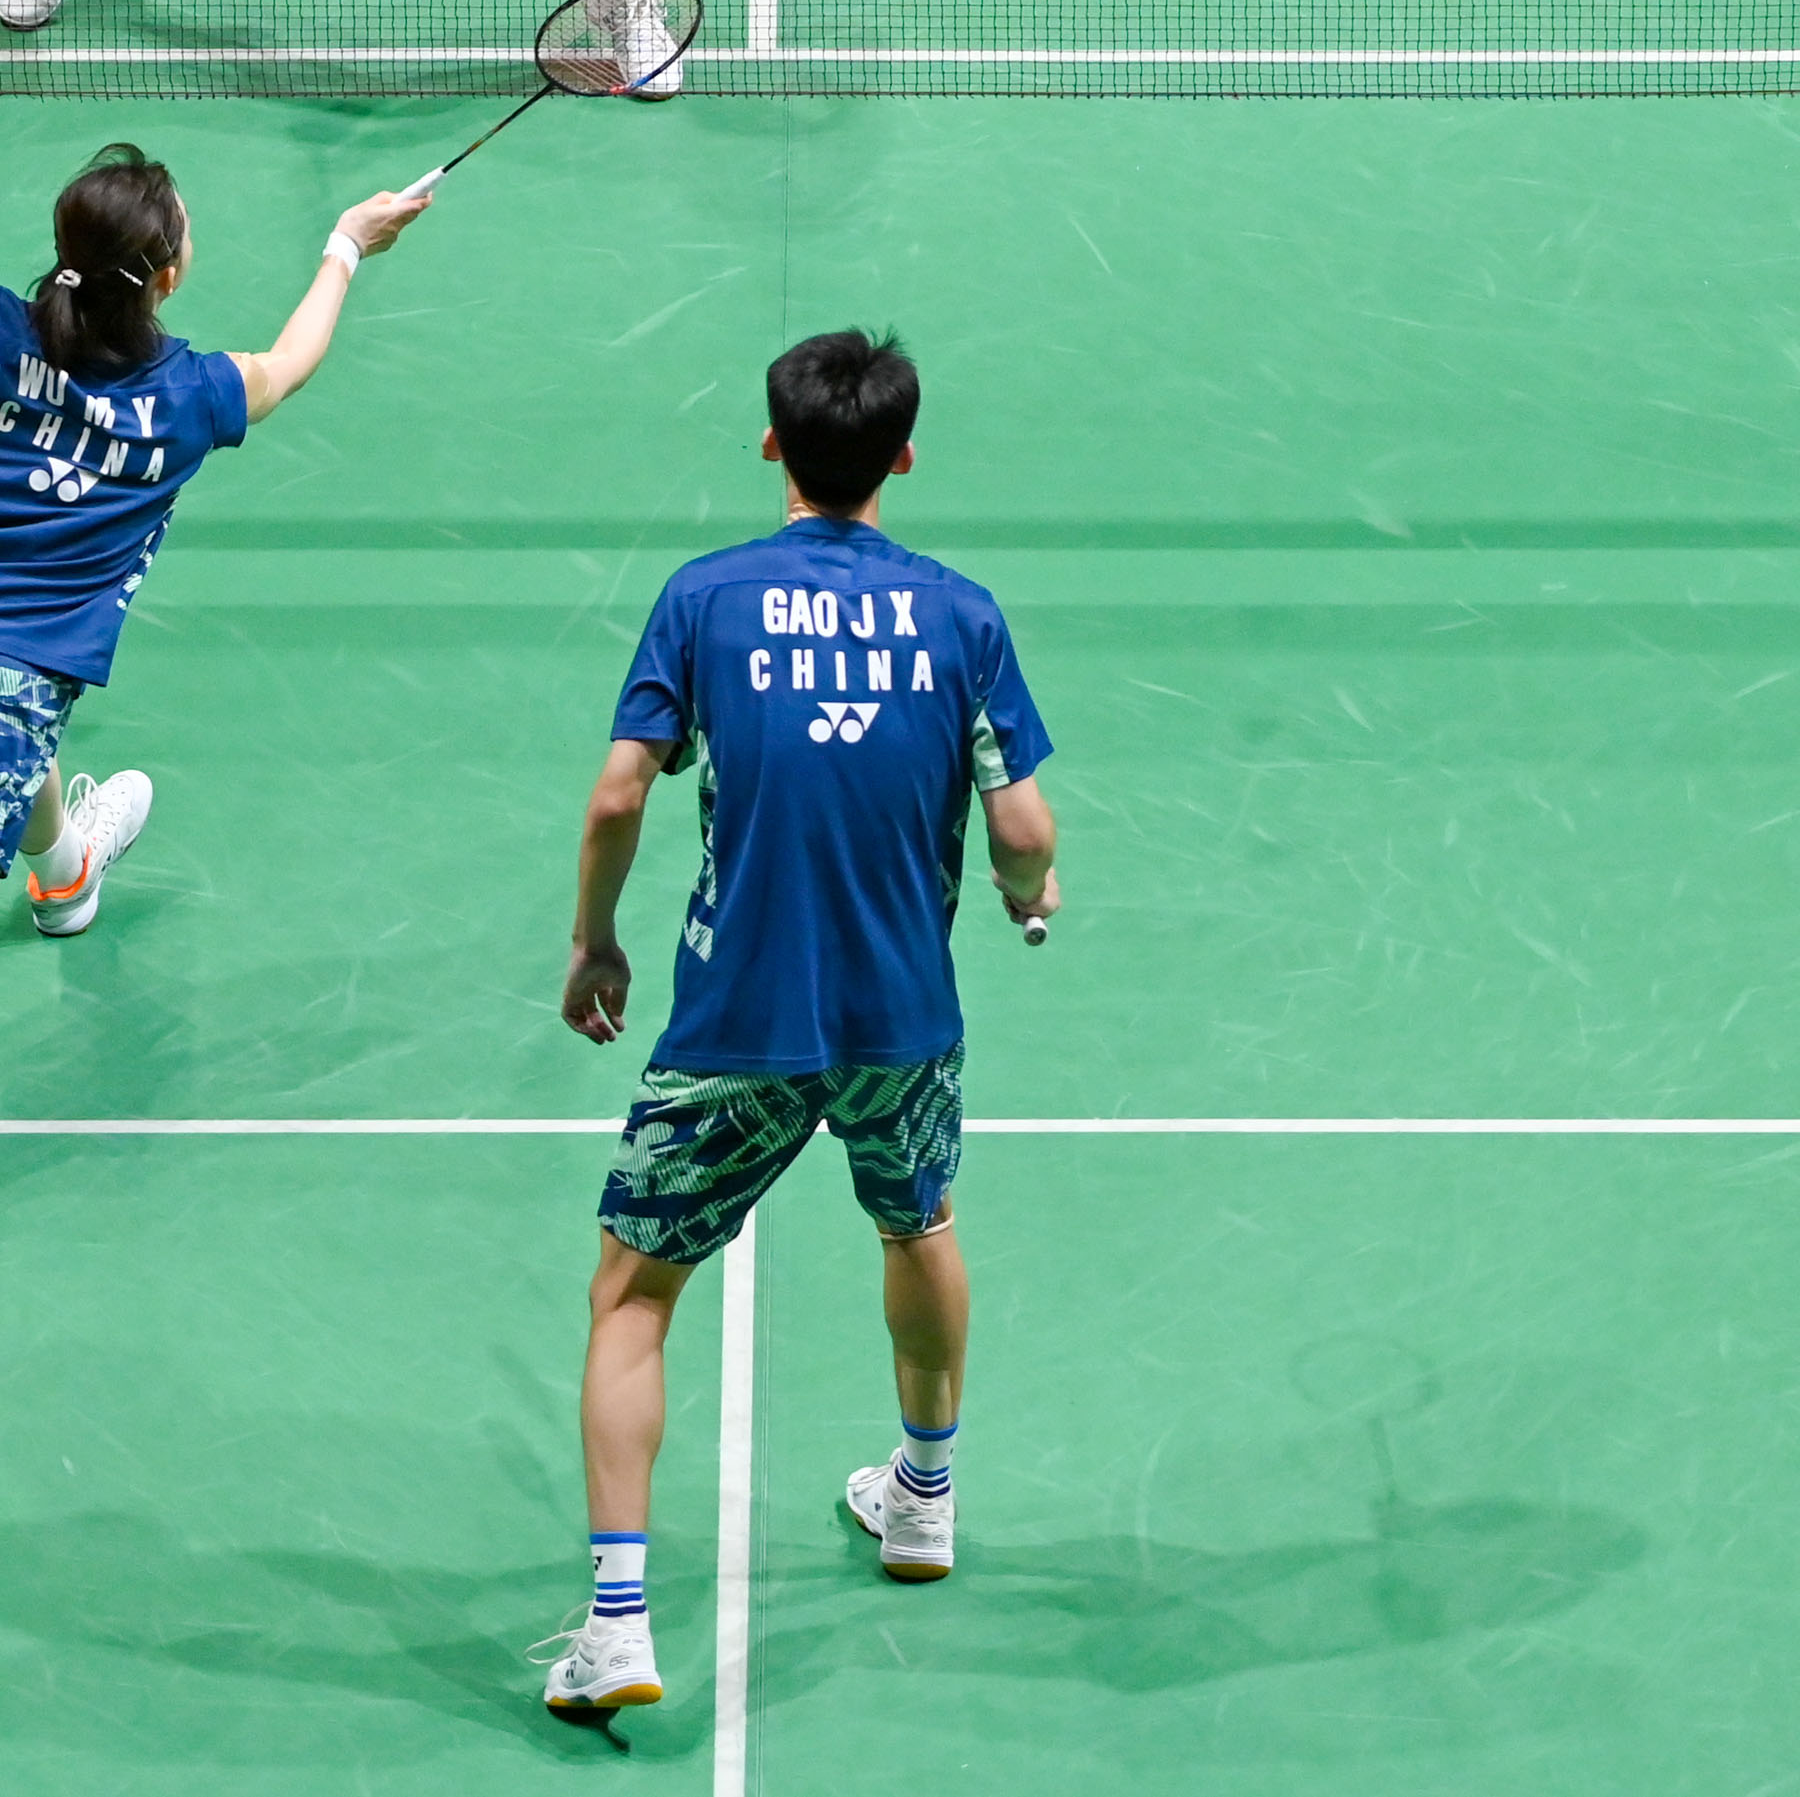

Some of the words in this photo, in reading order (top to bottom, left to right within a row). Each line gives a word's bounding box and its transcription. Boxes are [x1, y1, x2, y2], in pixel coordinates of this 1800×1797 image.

[17, 352, 69, 407] WU
[131, 395, 156, 438] Y
[762, 587, 838, 638] GAO
[849, 593, 875, 639] J
[893, 591, 918, 636] X
[749, 649, 935, 692] CHINA
